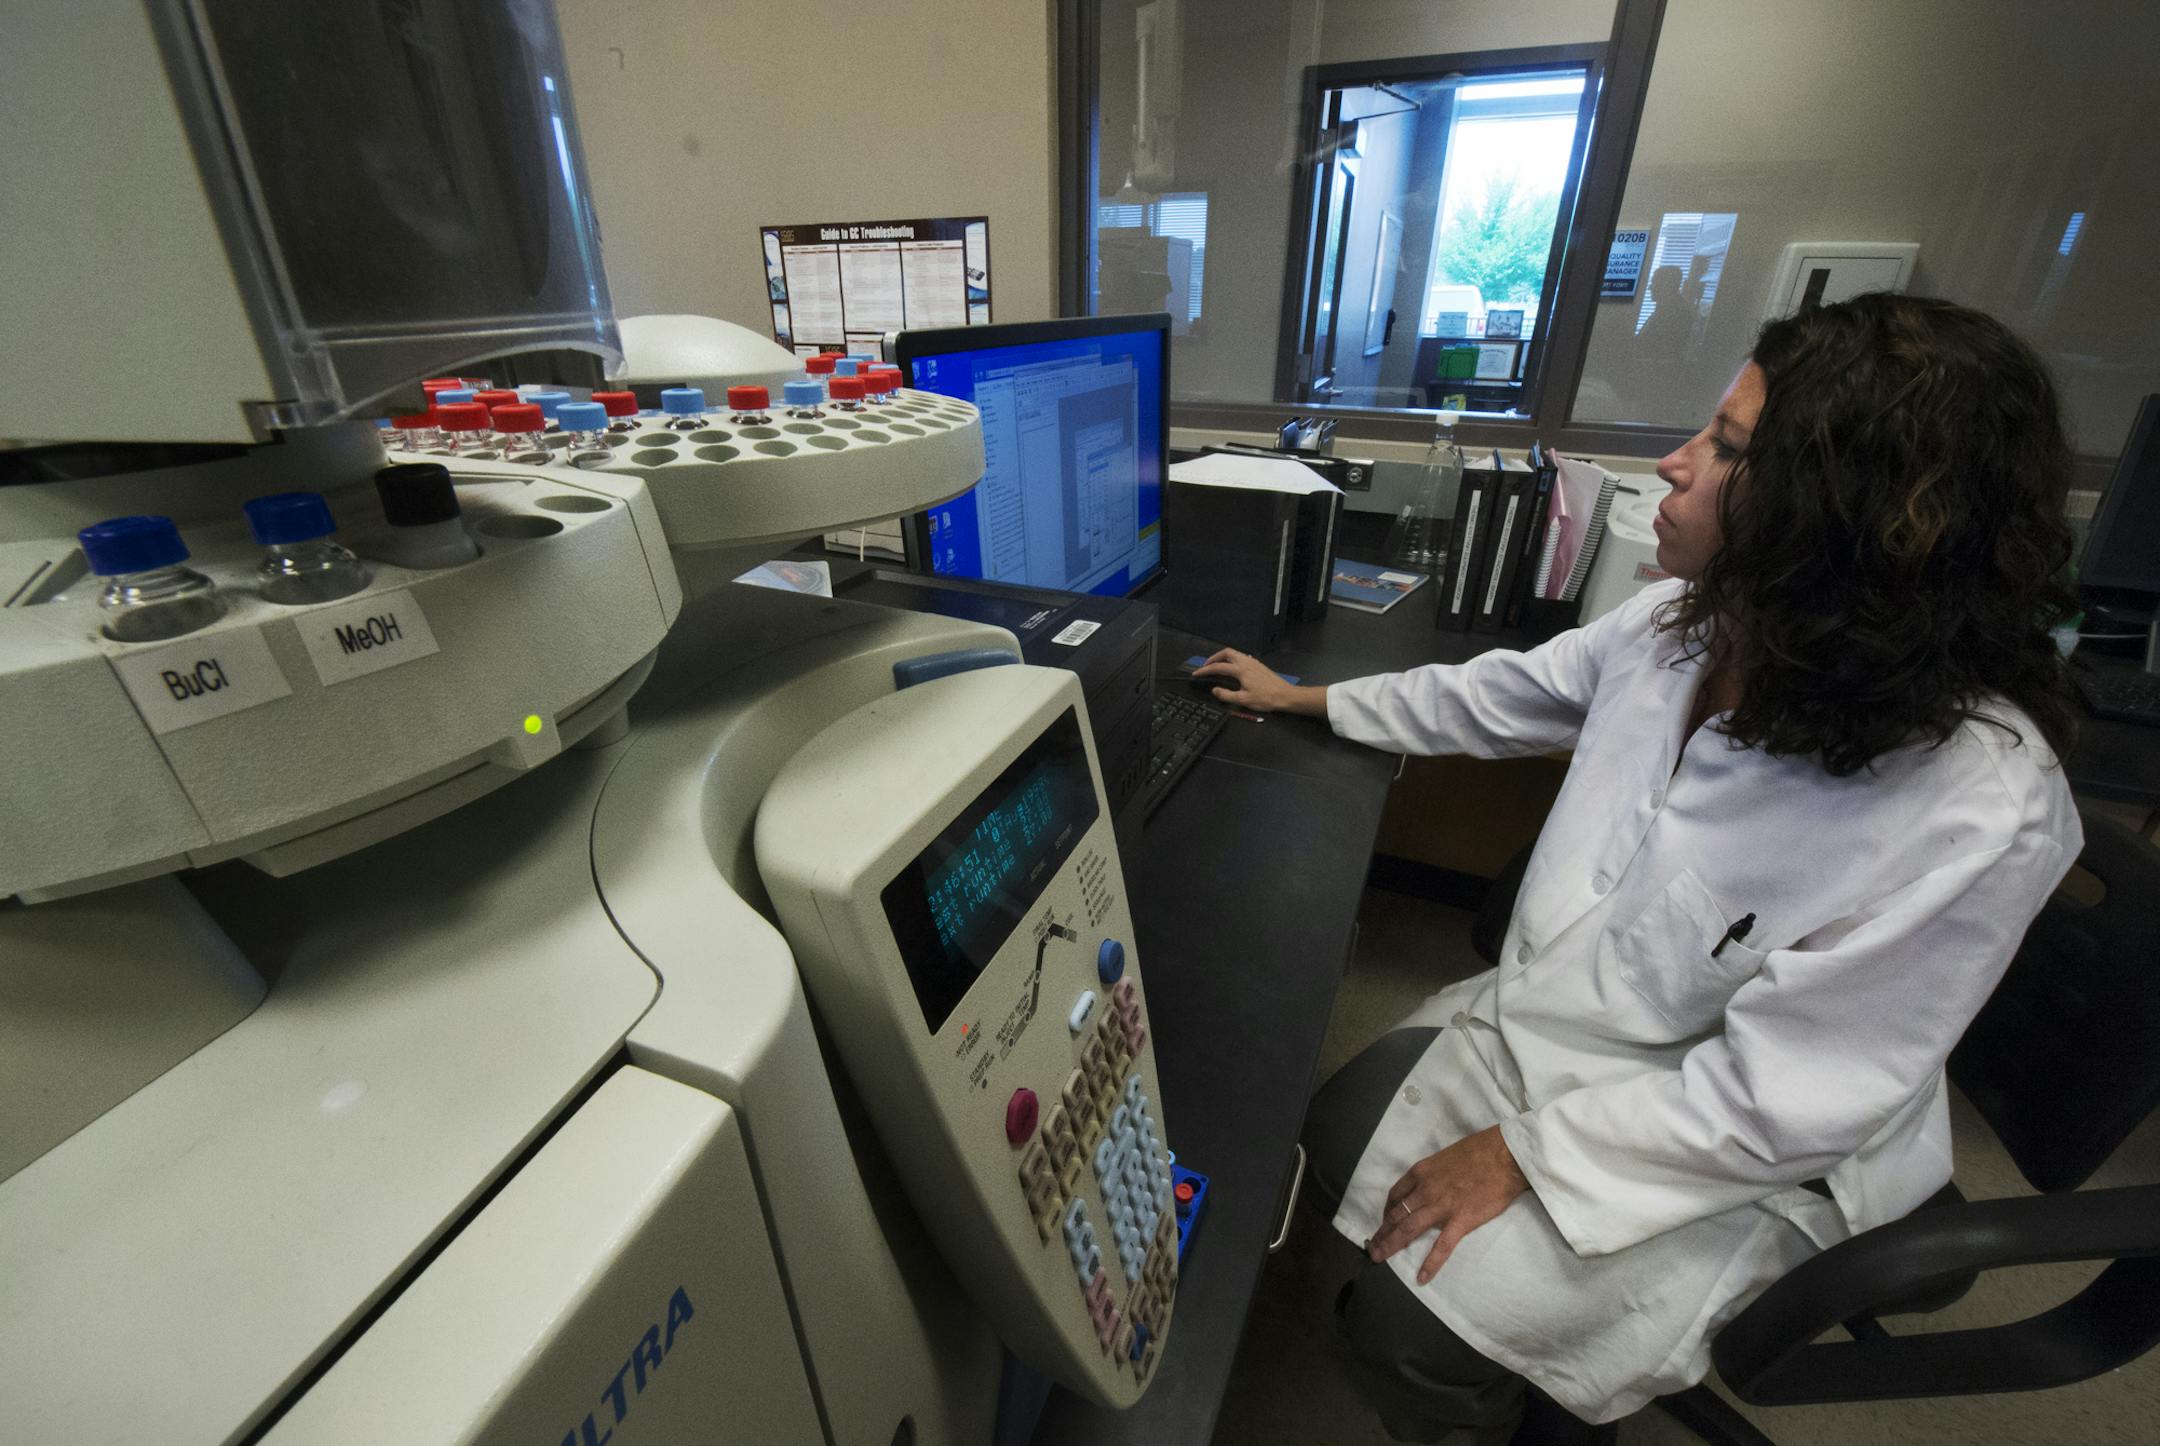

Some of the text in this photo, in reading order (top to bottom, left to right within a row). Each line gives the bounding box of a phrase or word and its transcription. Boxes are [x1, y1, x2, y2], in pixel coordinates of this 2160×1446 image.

[820, 224, 915, 240] Guide to GC Troubleshooting
[1607, 267, 1639, 275] ANAGER
[334, 613, 403, 655] MeOH
[161, 658, 230, 702] BuCl
[561, 1284, 695, 1446] LTRA
